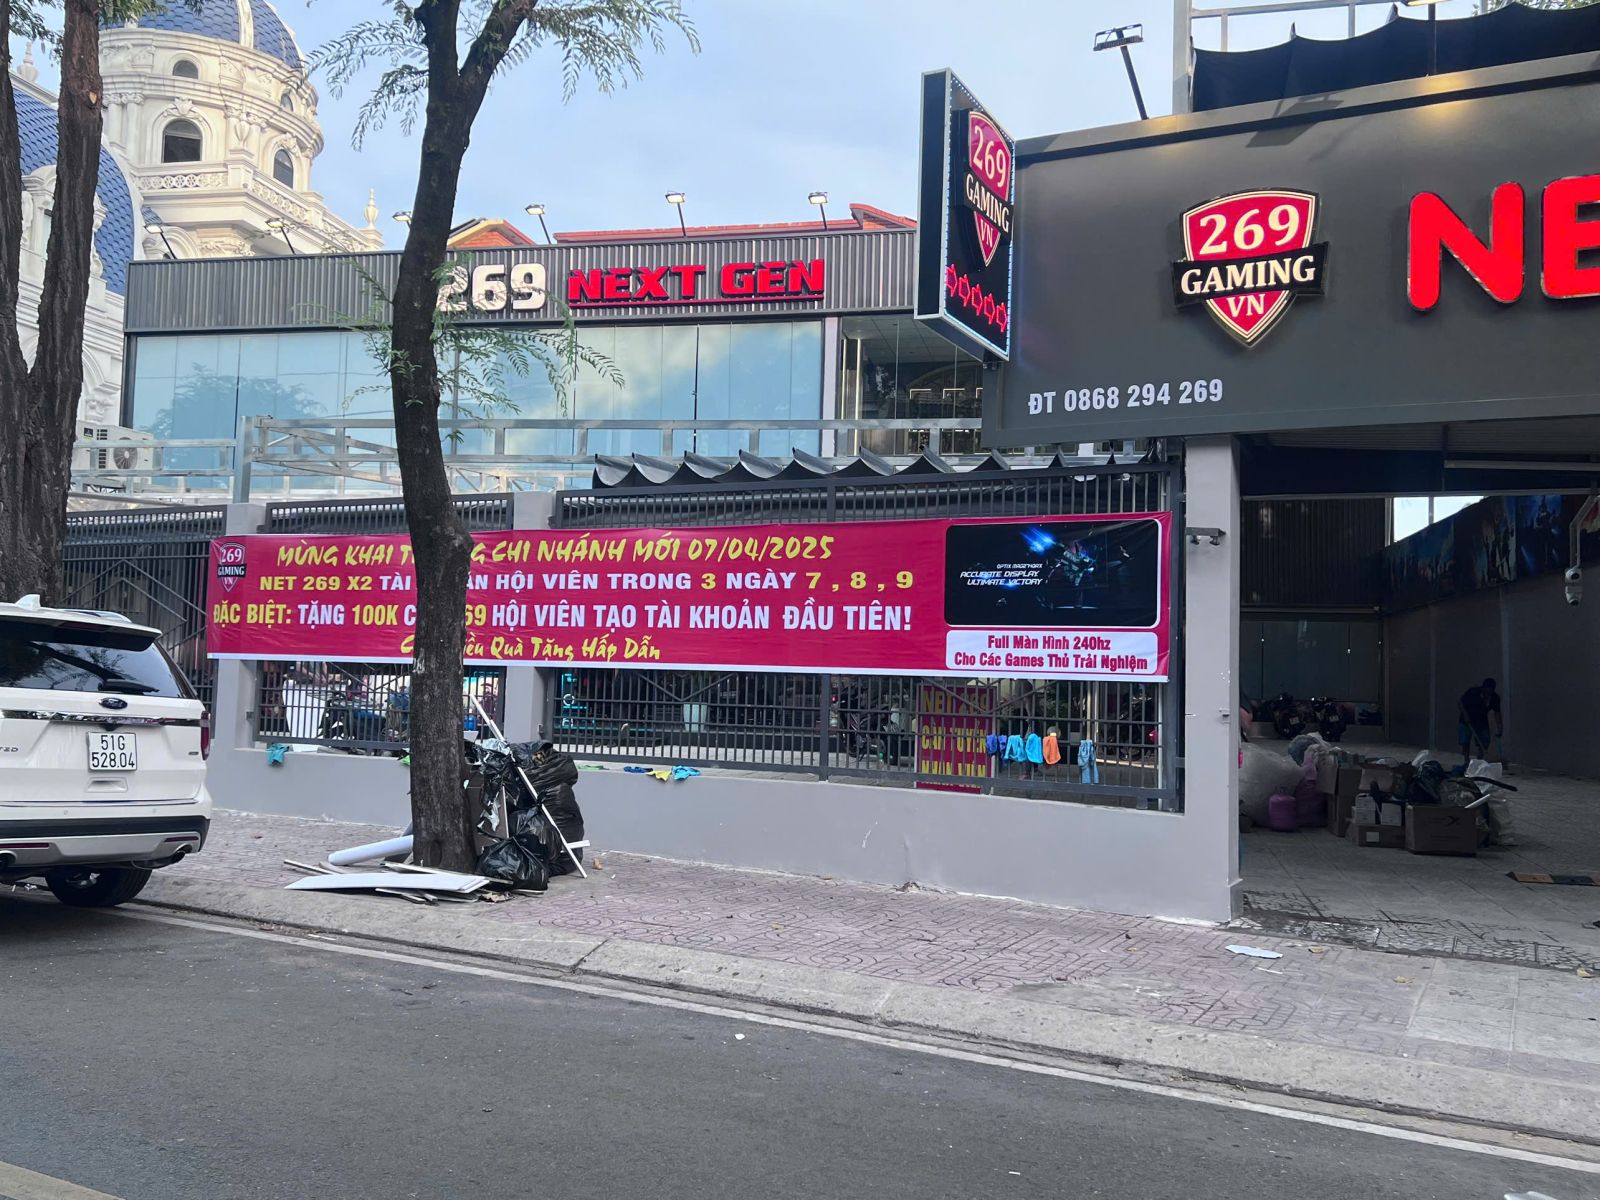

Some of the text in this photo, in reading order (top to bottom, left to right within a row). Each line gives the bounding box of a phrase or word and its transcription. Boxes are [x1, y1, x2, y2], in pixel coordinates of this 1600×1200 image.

[973, 125, 1007, 188] 269
[966, 173, 1010, 233] GAMING
[979, 219, 994, 248] VN
[1200, 204, 1300, 256] 269
[436, 259, 825, 312] 269 NEXT GEN
[1181, 254, 1315, 296] GAMING
[1226, 293, 1266, 317] VN
[1028, 378, 1223, 416] ĐT 0868 294 269
[221, 548, 242, 563] 269
[345, 544, 394, 566] KHAI
[492, 540, 531, 562] CHI
[537, 532, 627, 563] NHÁNH
[633, 531, 681, 563] MỚI
[688, 536, 834, 563] 07/04/2025
[260, 577, 297, 591] NET
[303, 576, 340, 591] 269
[348, 576, 373, 591] X2
[380, 571, 412, 591] TÀI
[496, 570, 534, 594] HỘI
[543, 570, 598, 590] VIÊN
[607, 573, 692, 590] TRONG
[701, 573, 716, 589] 3
[726, 569, 796, 590] NGÀY
[806, 573, 821, 589] 7
[850, 571, 867, 589] 8
[896, 571, 914, 588] 9
[1003, 570, 1040, 578] DISPLAY
[213, 600, 241, 628] ĐẶC
[247, 599, 292, 629] BIỆT:
[298, 600, 345, 630] TẶNG
[352, 604, 398, 626] 100K
[492, 600, 527, 632] HỘI
[534, 599, 585, 628] VIÊN
[593, 604, 637, 633] TẠO
[645, 600, 680, 629] TÀI
[690, 599, 770, 629] KHOẢN
[783, 597, 834, 630] ĐẦU
[843, 600, 912, 631] TIÊN!
[490, 637, 523, 659] Quà
[531, 637, 574, 662] Tặng
[582, 633, 618, 662] Hấp
[624, 635, 661, 660] Dẫn
[987, 635, 1111, 651] Full Màn Hình 240hz
[954, 652, 1148, 673] Cho Các Games Thủ Trải Nghiệm
[100, 735, 126, 751] 51G
[91, 752, 135, 768] 528.04
